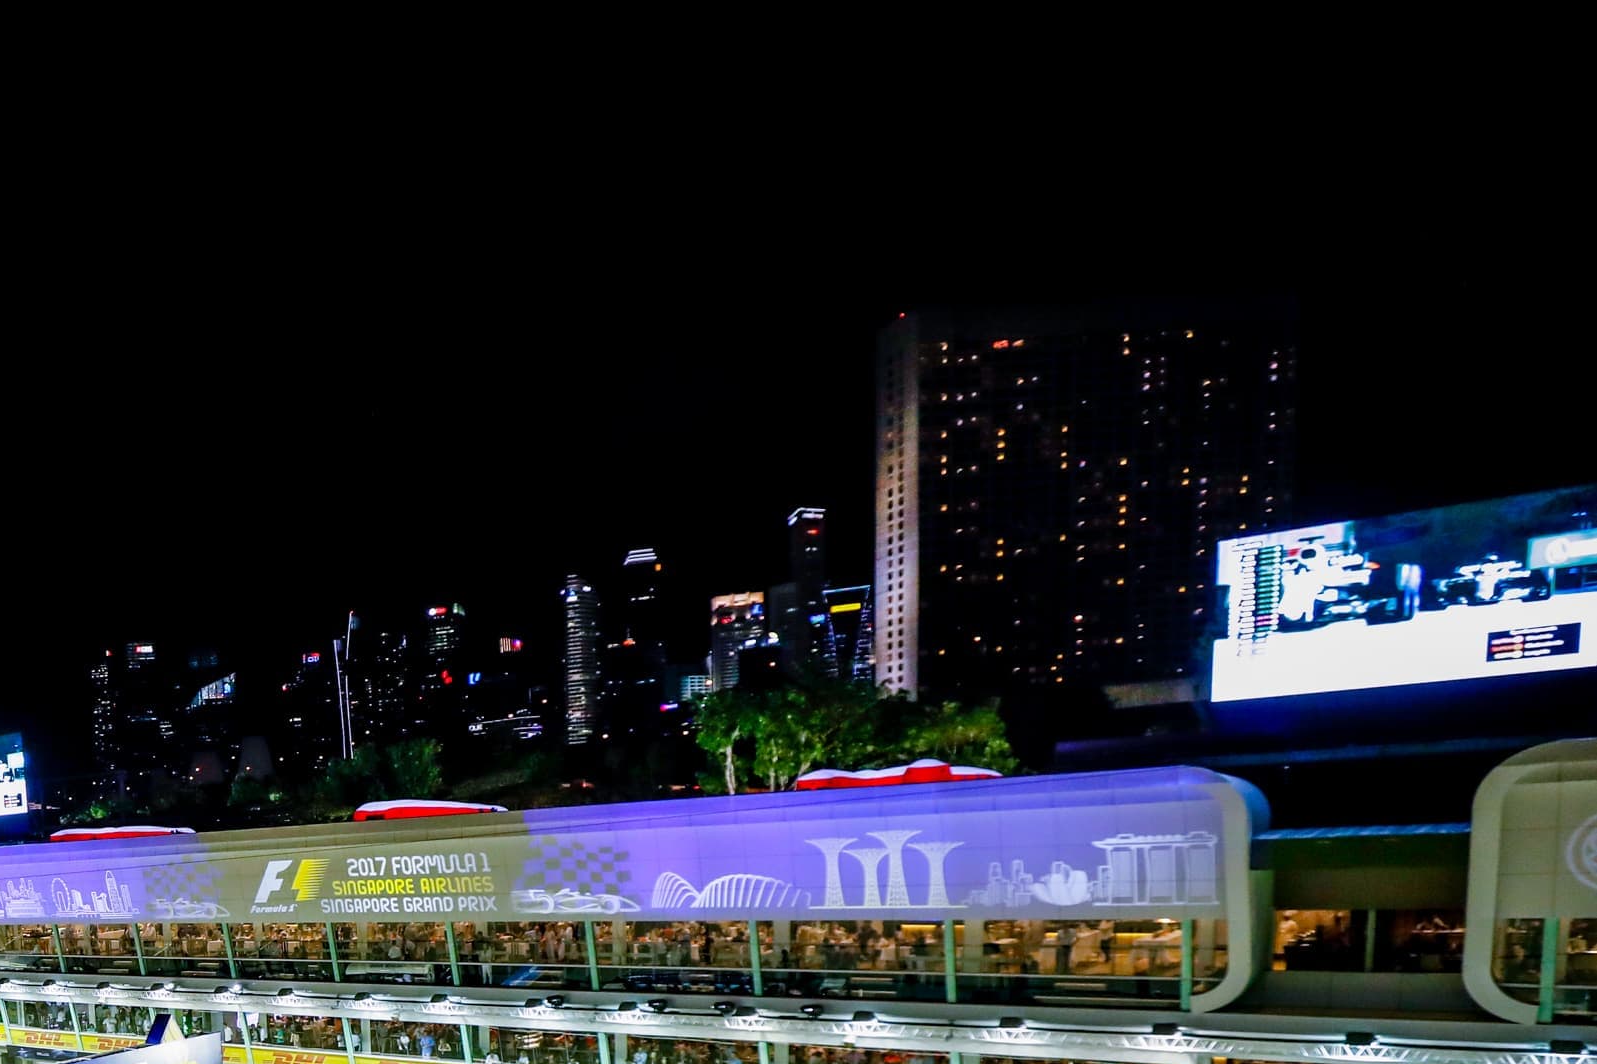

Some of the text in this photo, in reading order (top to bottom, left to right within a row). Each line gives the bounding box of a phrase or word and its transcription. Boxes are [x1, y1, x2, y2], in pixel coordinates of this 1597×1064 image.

[346, 852, 491, 877] 2017 FORMULA 1
[332, 876, 495, 896] SINGAPORE AIRLINES
[249, 904, 288, 914] Formula
[320, 895, 498, 914] SINGAPORE GRAND PRIX
[24, 1032, 65, 1046] DHL
